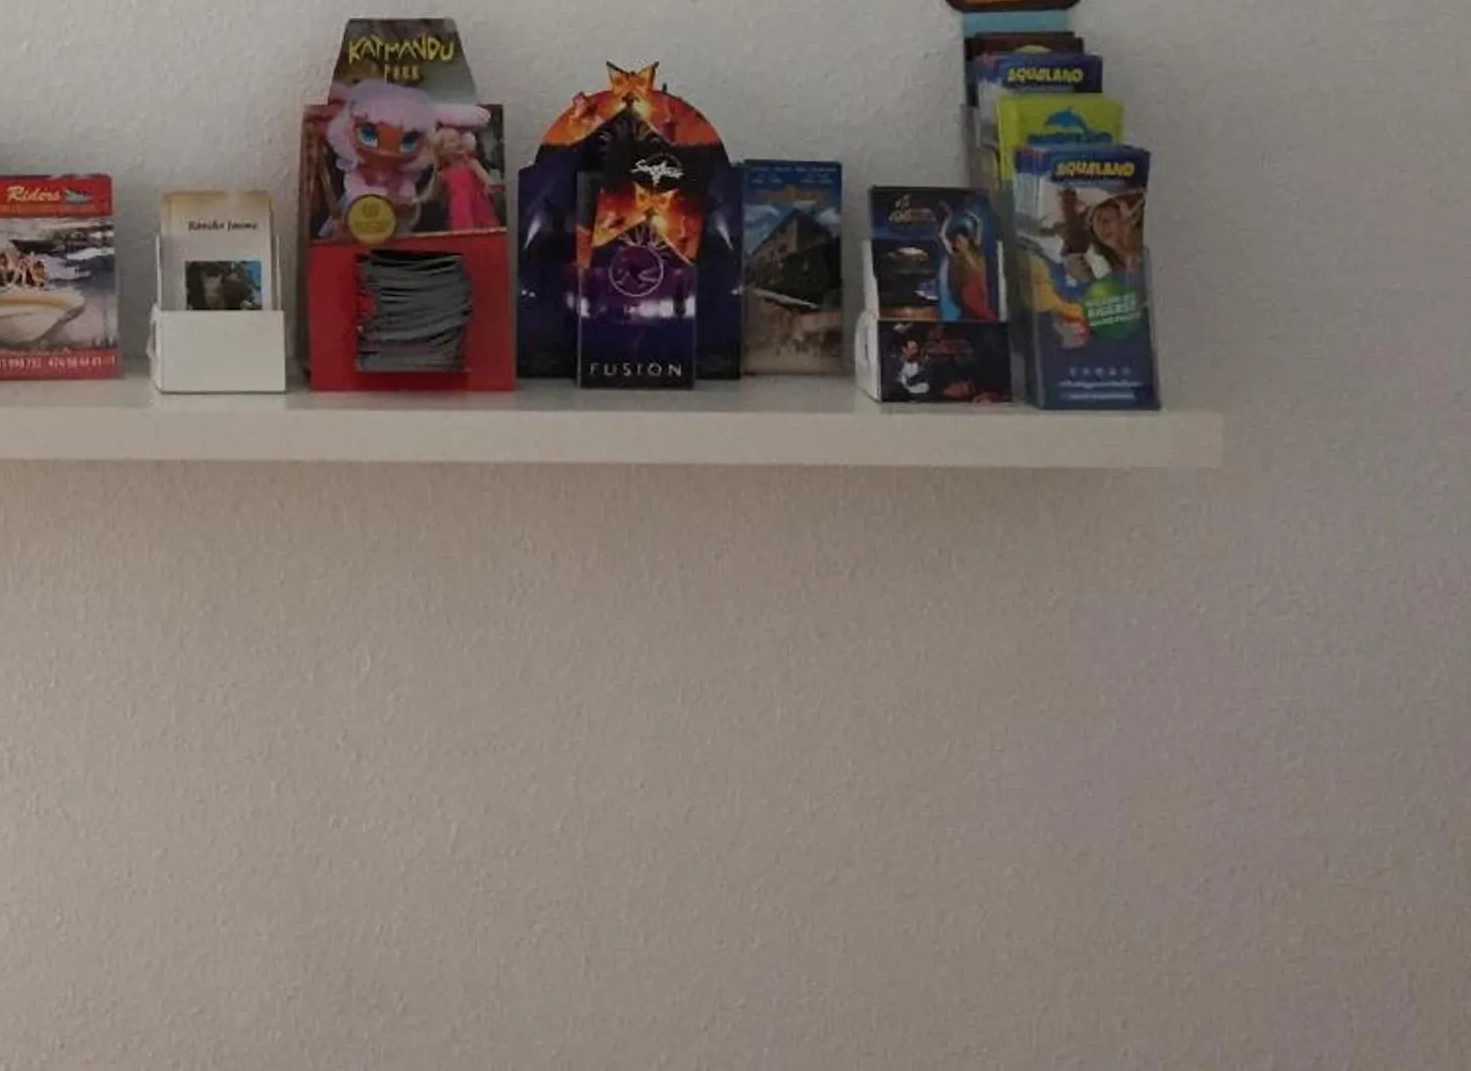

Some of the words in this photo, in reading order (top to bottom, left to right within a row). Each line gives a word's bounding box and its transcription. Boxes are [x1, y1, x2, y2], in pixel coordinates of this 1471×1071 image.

[348, 33, 455, 65] KATMANDU
[1006, 66, 1085, 84] AQUALAND
[1054, 159, 1137, 178] AQUALAND
[6, 184, 61, 203] Riders
[589, 362, 683, 377] FUSION
